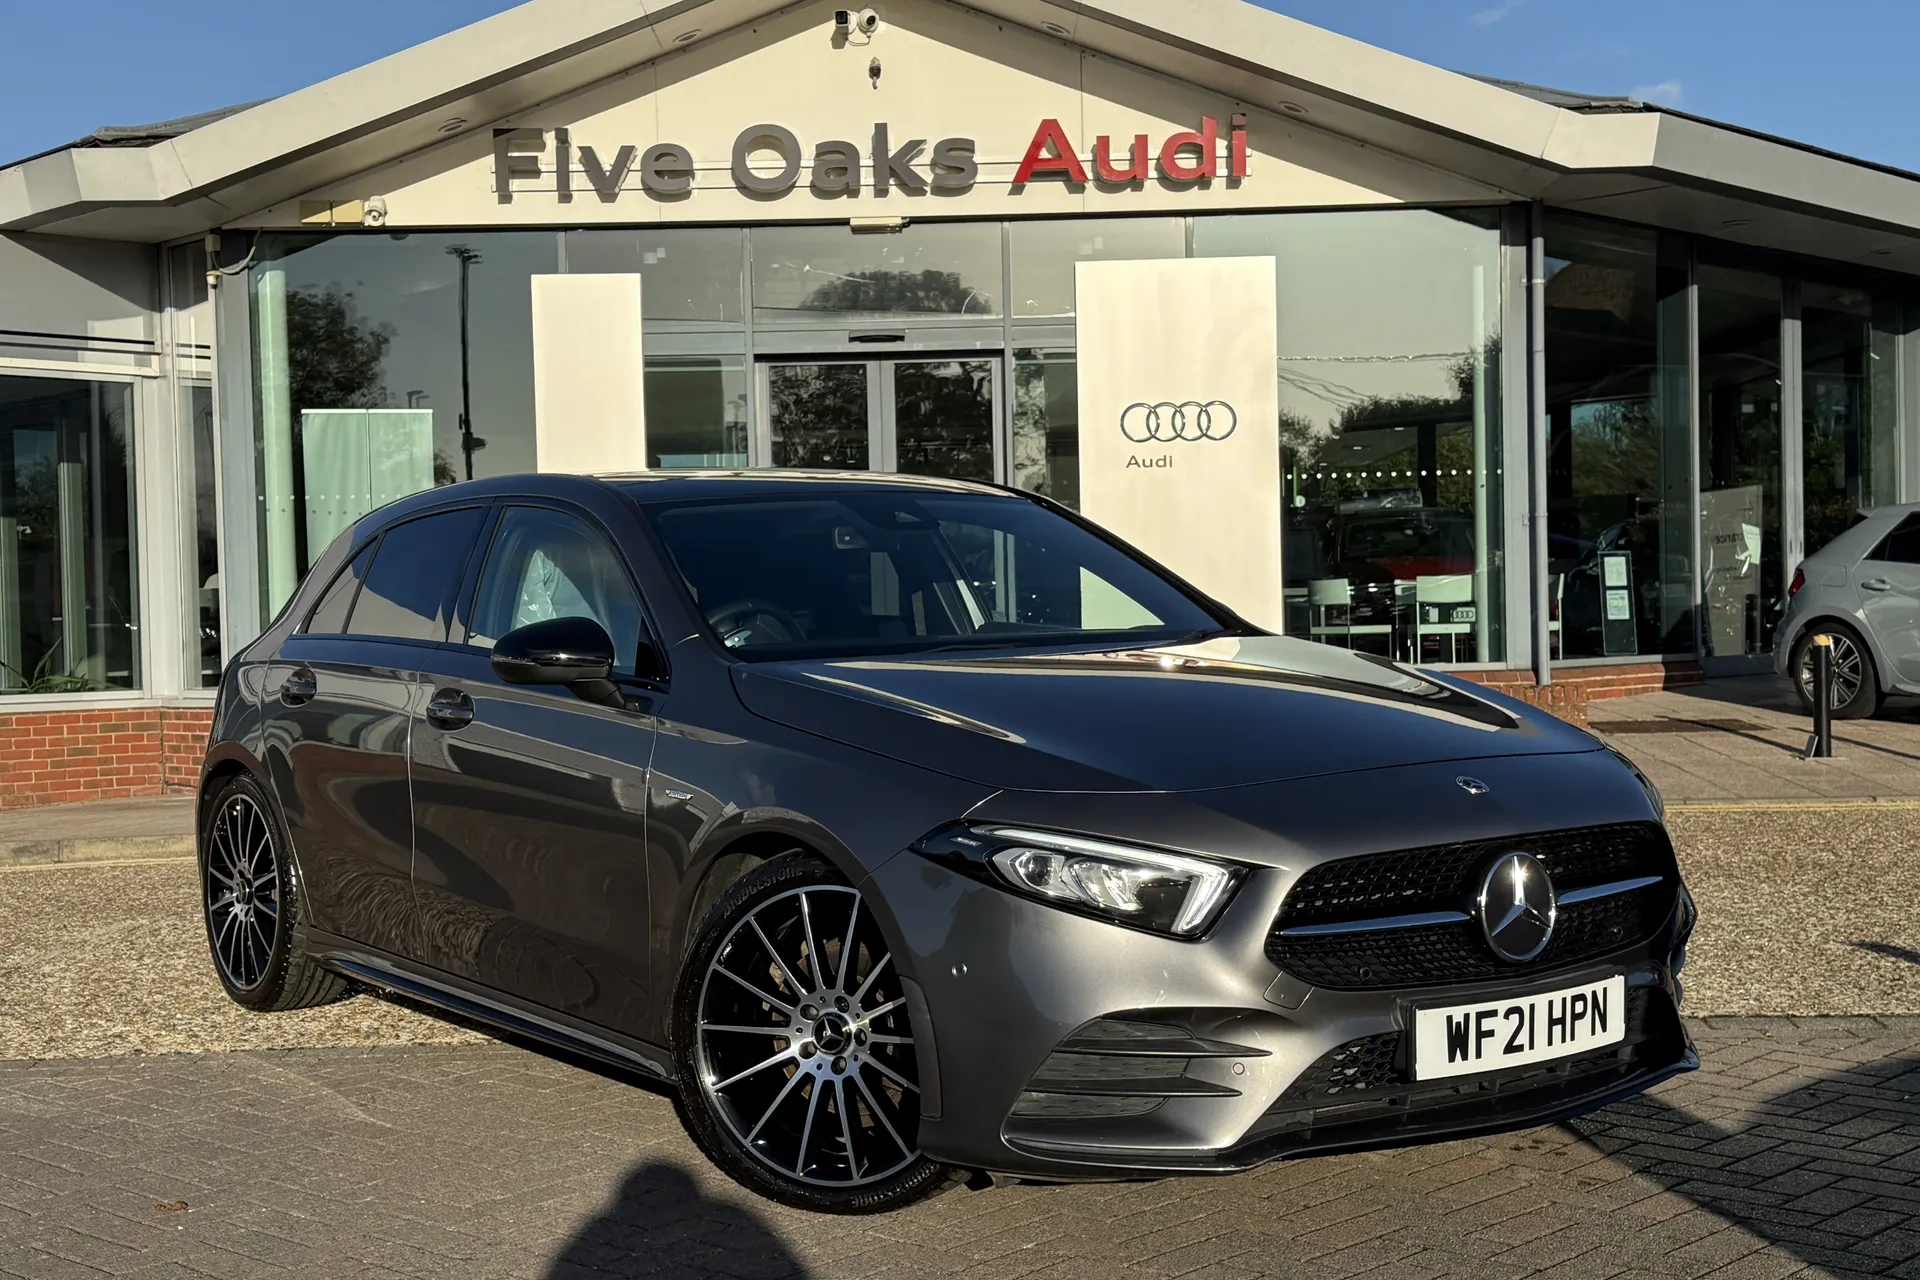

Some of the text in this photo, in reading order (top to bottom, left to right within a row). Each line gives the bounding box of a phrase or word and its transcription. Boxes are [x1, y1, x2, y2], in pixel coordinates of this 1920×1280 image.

[493, 113, 1247, 196] Five Oaks Audi
[1125, 454, 1173, 469] Audi
[1446, 986, 1608, 1064] WF21 HPN
